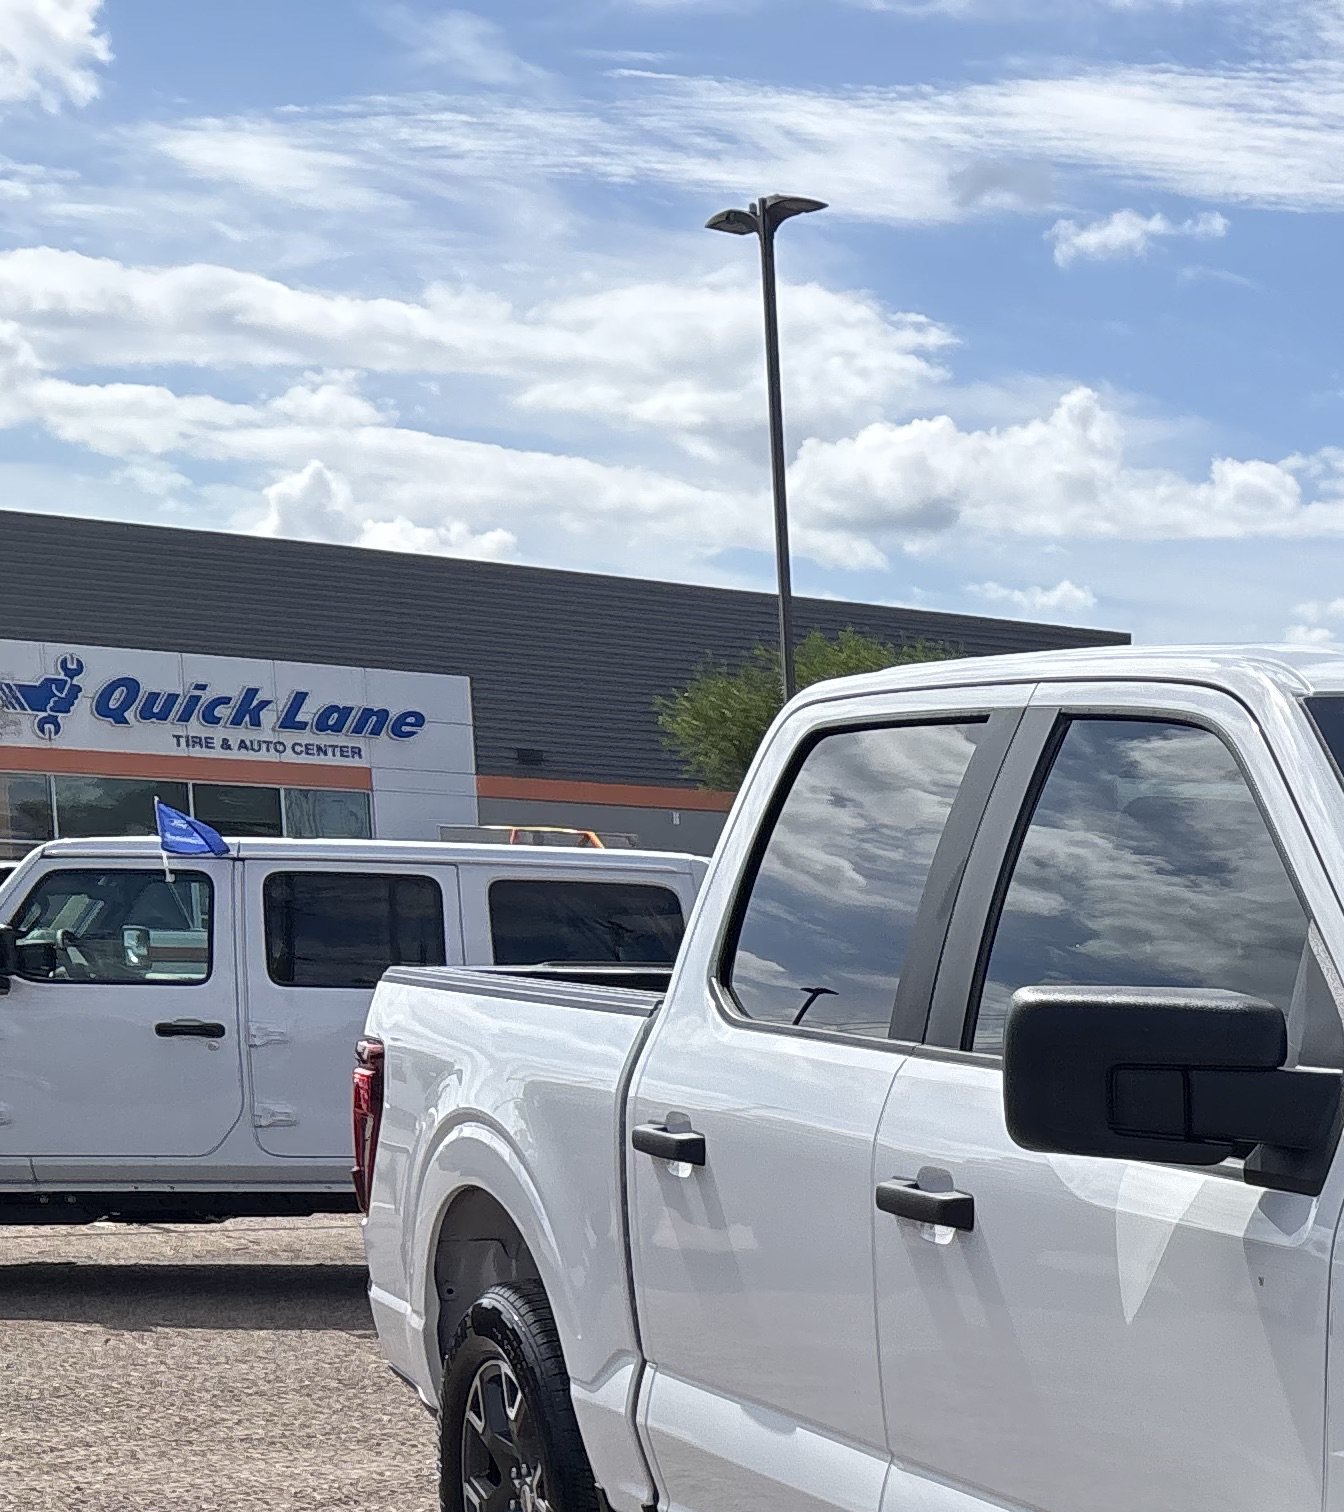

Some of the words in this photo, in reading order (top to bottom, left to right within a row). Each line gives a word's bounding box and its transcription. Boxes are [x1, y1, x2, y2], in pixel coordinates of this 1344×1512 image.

[94, 676, 277, 728] Quick
[278, 691, 426, 738] Lane
[172, 734, 215, 750] TIRE
[220, 738, 232, 751] &
[238, 739, 286, 755] AUTO
[291, 742, 363, 760] CENTER
